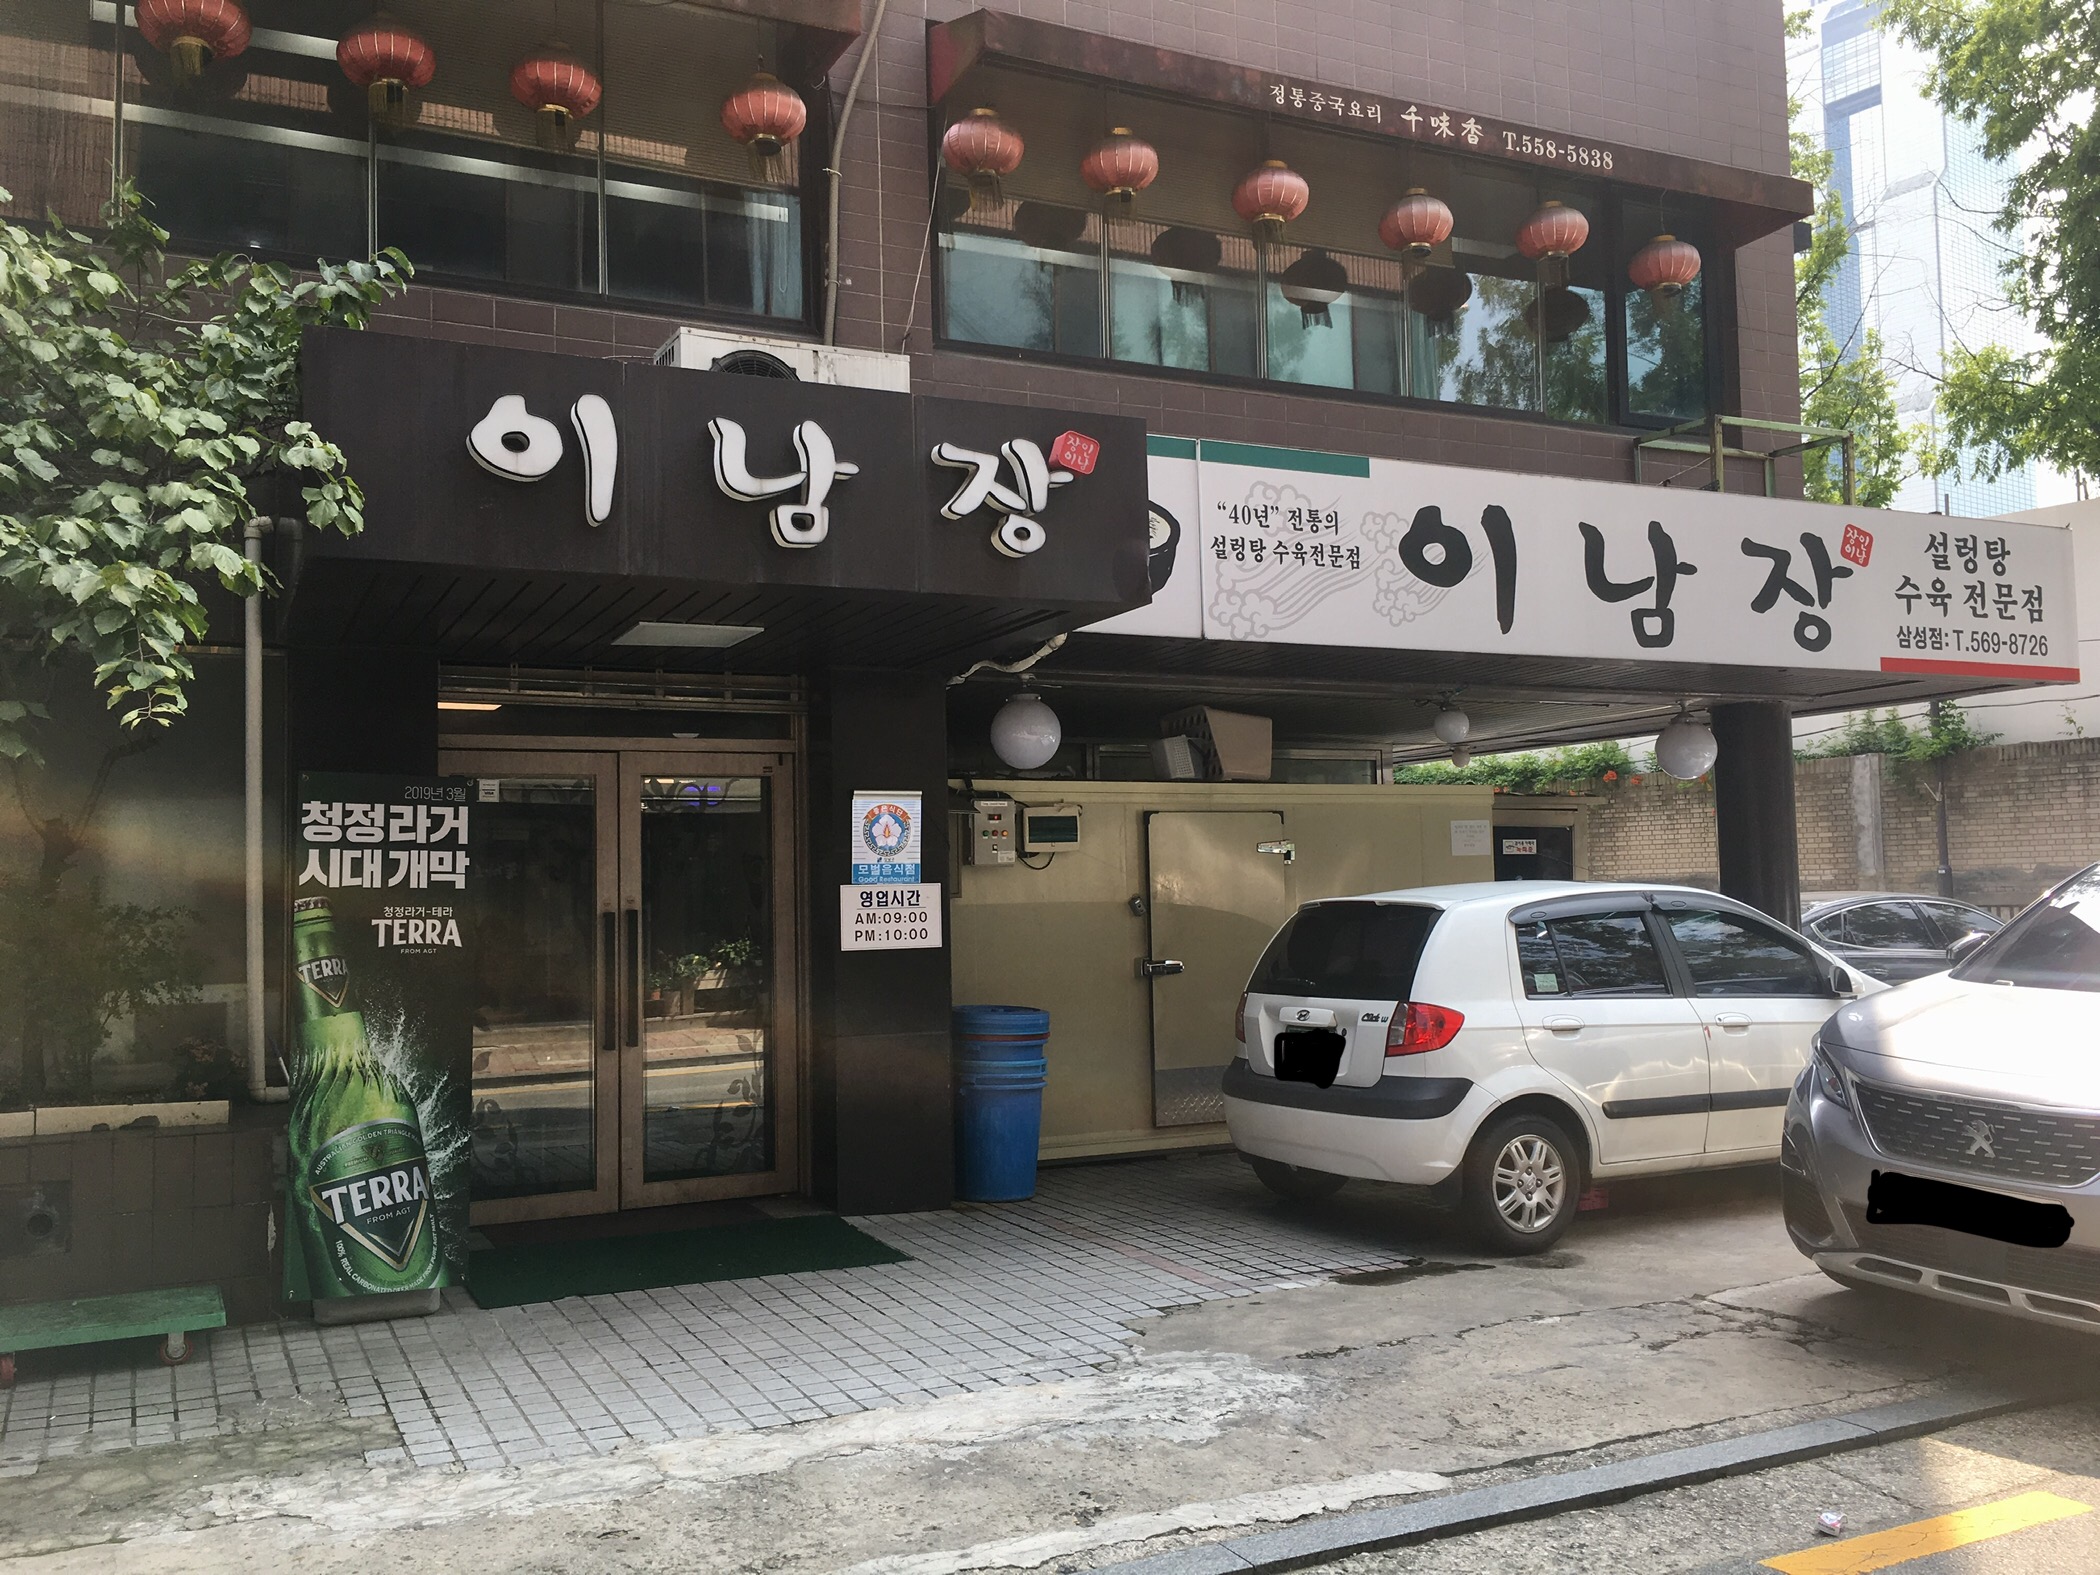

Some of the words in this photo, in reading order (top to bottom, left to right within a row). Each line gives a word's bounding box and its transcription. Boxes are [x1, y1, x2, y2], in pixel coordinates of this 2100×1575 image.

[1269, 84, 1382, 124] 정통중국요리
[1502, 130, 1614, 170] T.558-5838
[1287, 507, 1339, 536] 전통의
[1210, 535, 1267, 563] 설렁탕
[1273, 540, 1361, 570] 수육전문점
[1924, 531, 2011, 577] 설렁탕
[404, 786, 444, 801] 2019년
[446, 787, 466, 802] 3월
[859, 890, 921, 908] 영업시간
[371, 919, 463, 948] TERRA
[298, 958, 349, 984] TERRA
[321, 1166, 430, 1225] TERRA
[366, 1213, 394, 1225] FROM
[396, 1206, 412, 1216] AGT
[340, 1257, 352, 1276] REAL
